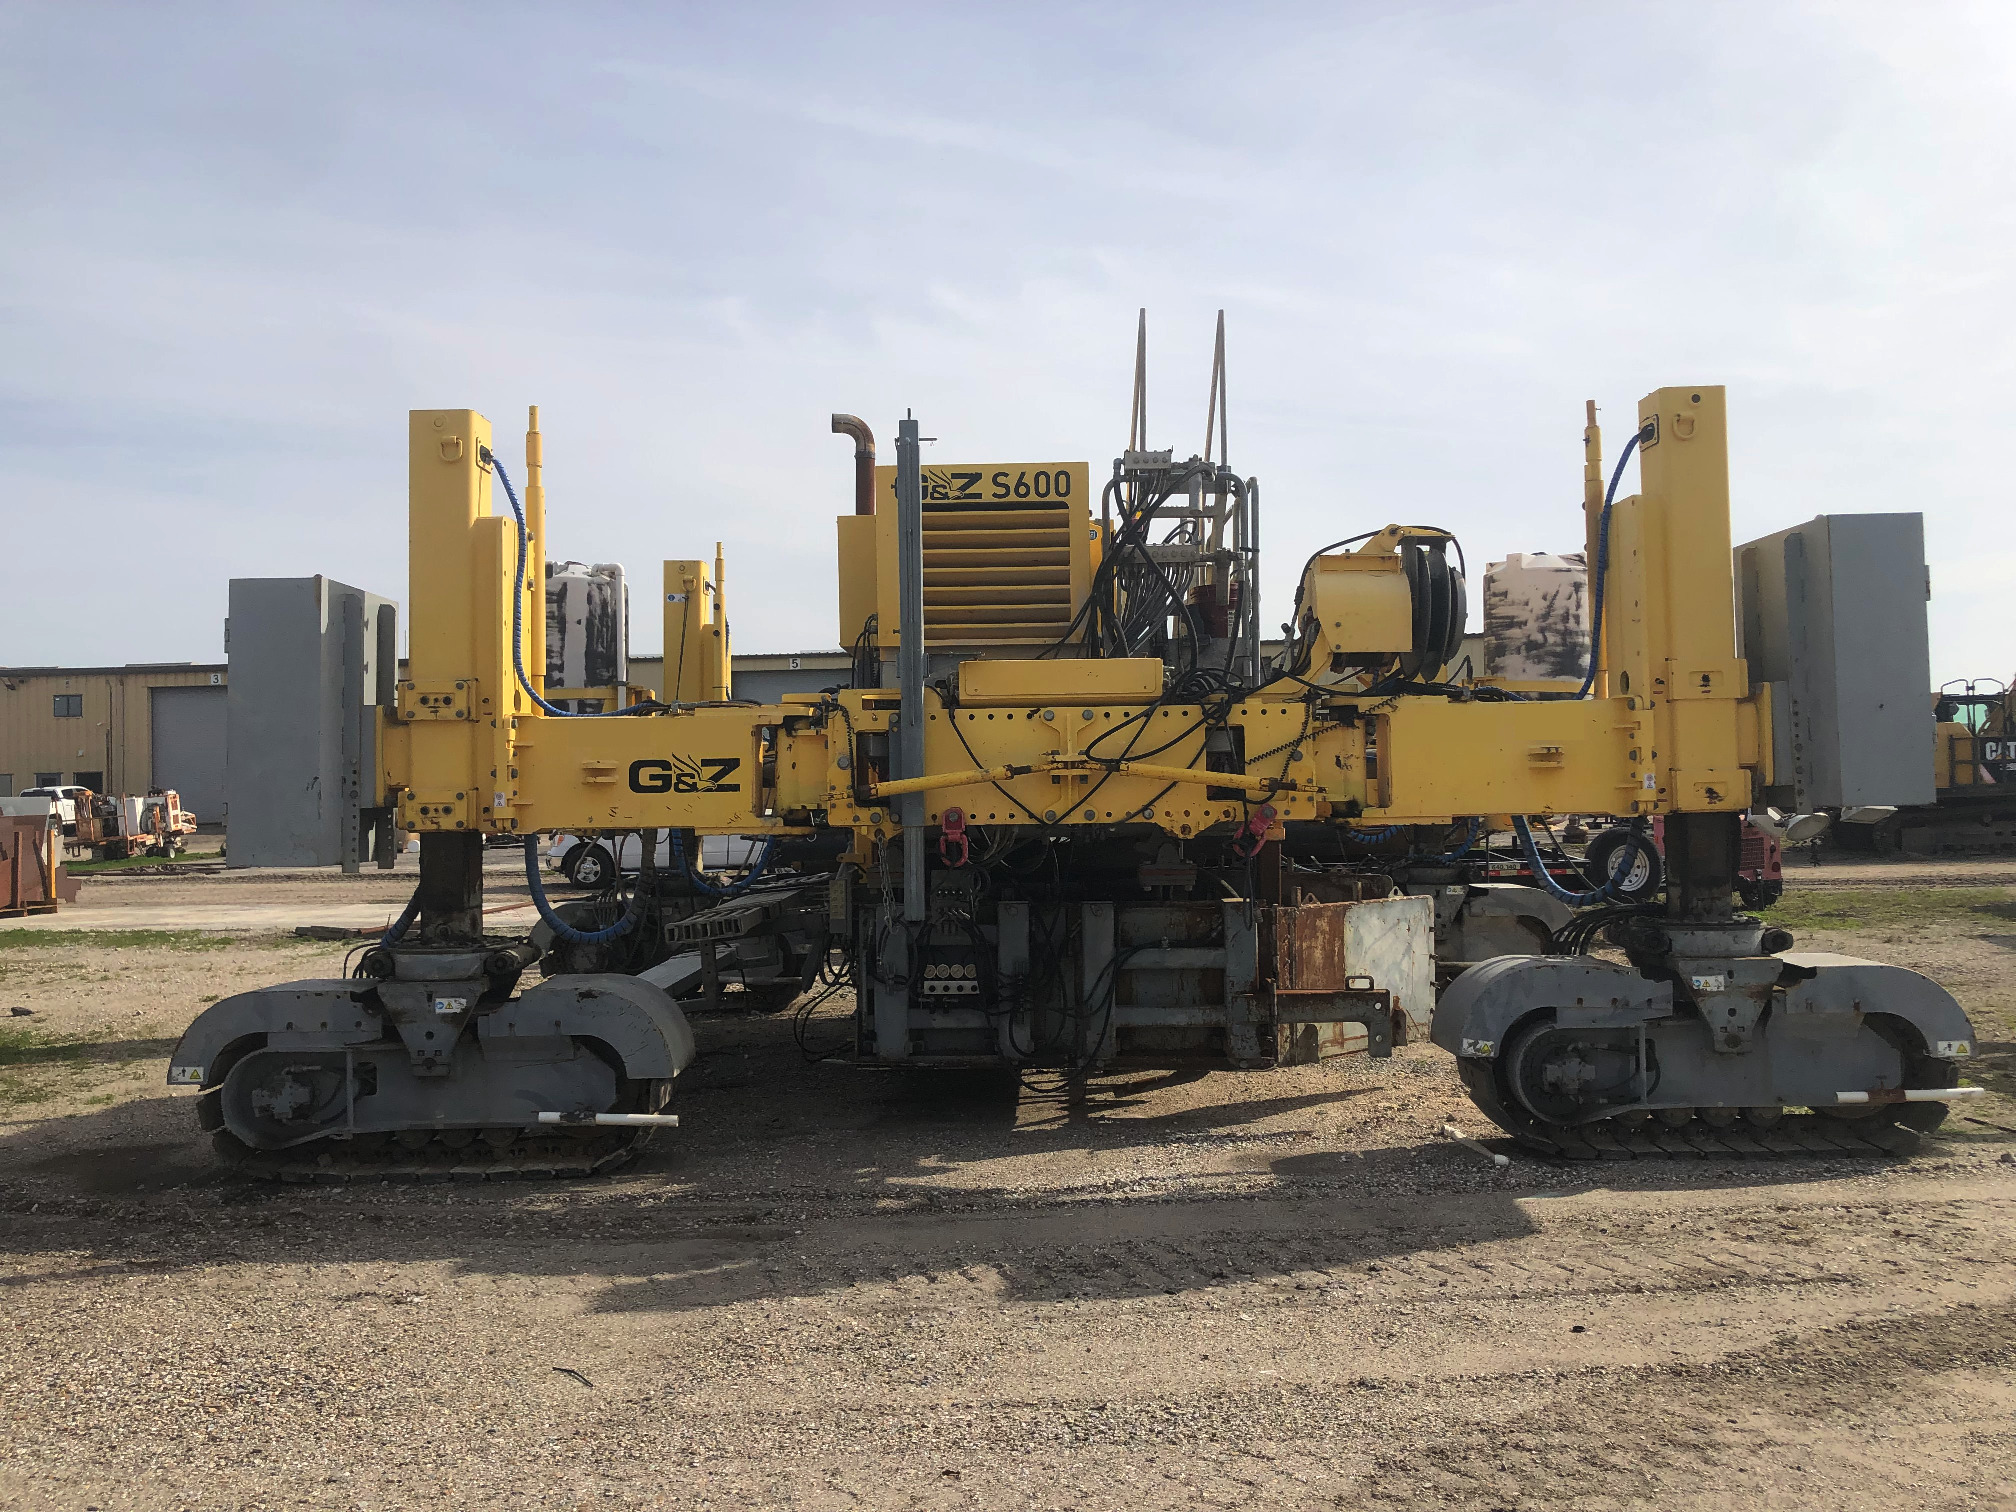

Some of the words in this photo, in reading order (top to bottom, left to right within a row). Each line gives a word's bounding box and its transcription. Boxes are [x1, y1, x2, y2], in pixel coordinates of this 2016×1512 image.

[895, 470, 982, 500] &Z
[992, 470, 1071, 499] S600
[791, 658, 799, 669] 5
[212, 674, 220, 684] 3
[628, 757, 740, 793] G&Z
